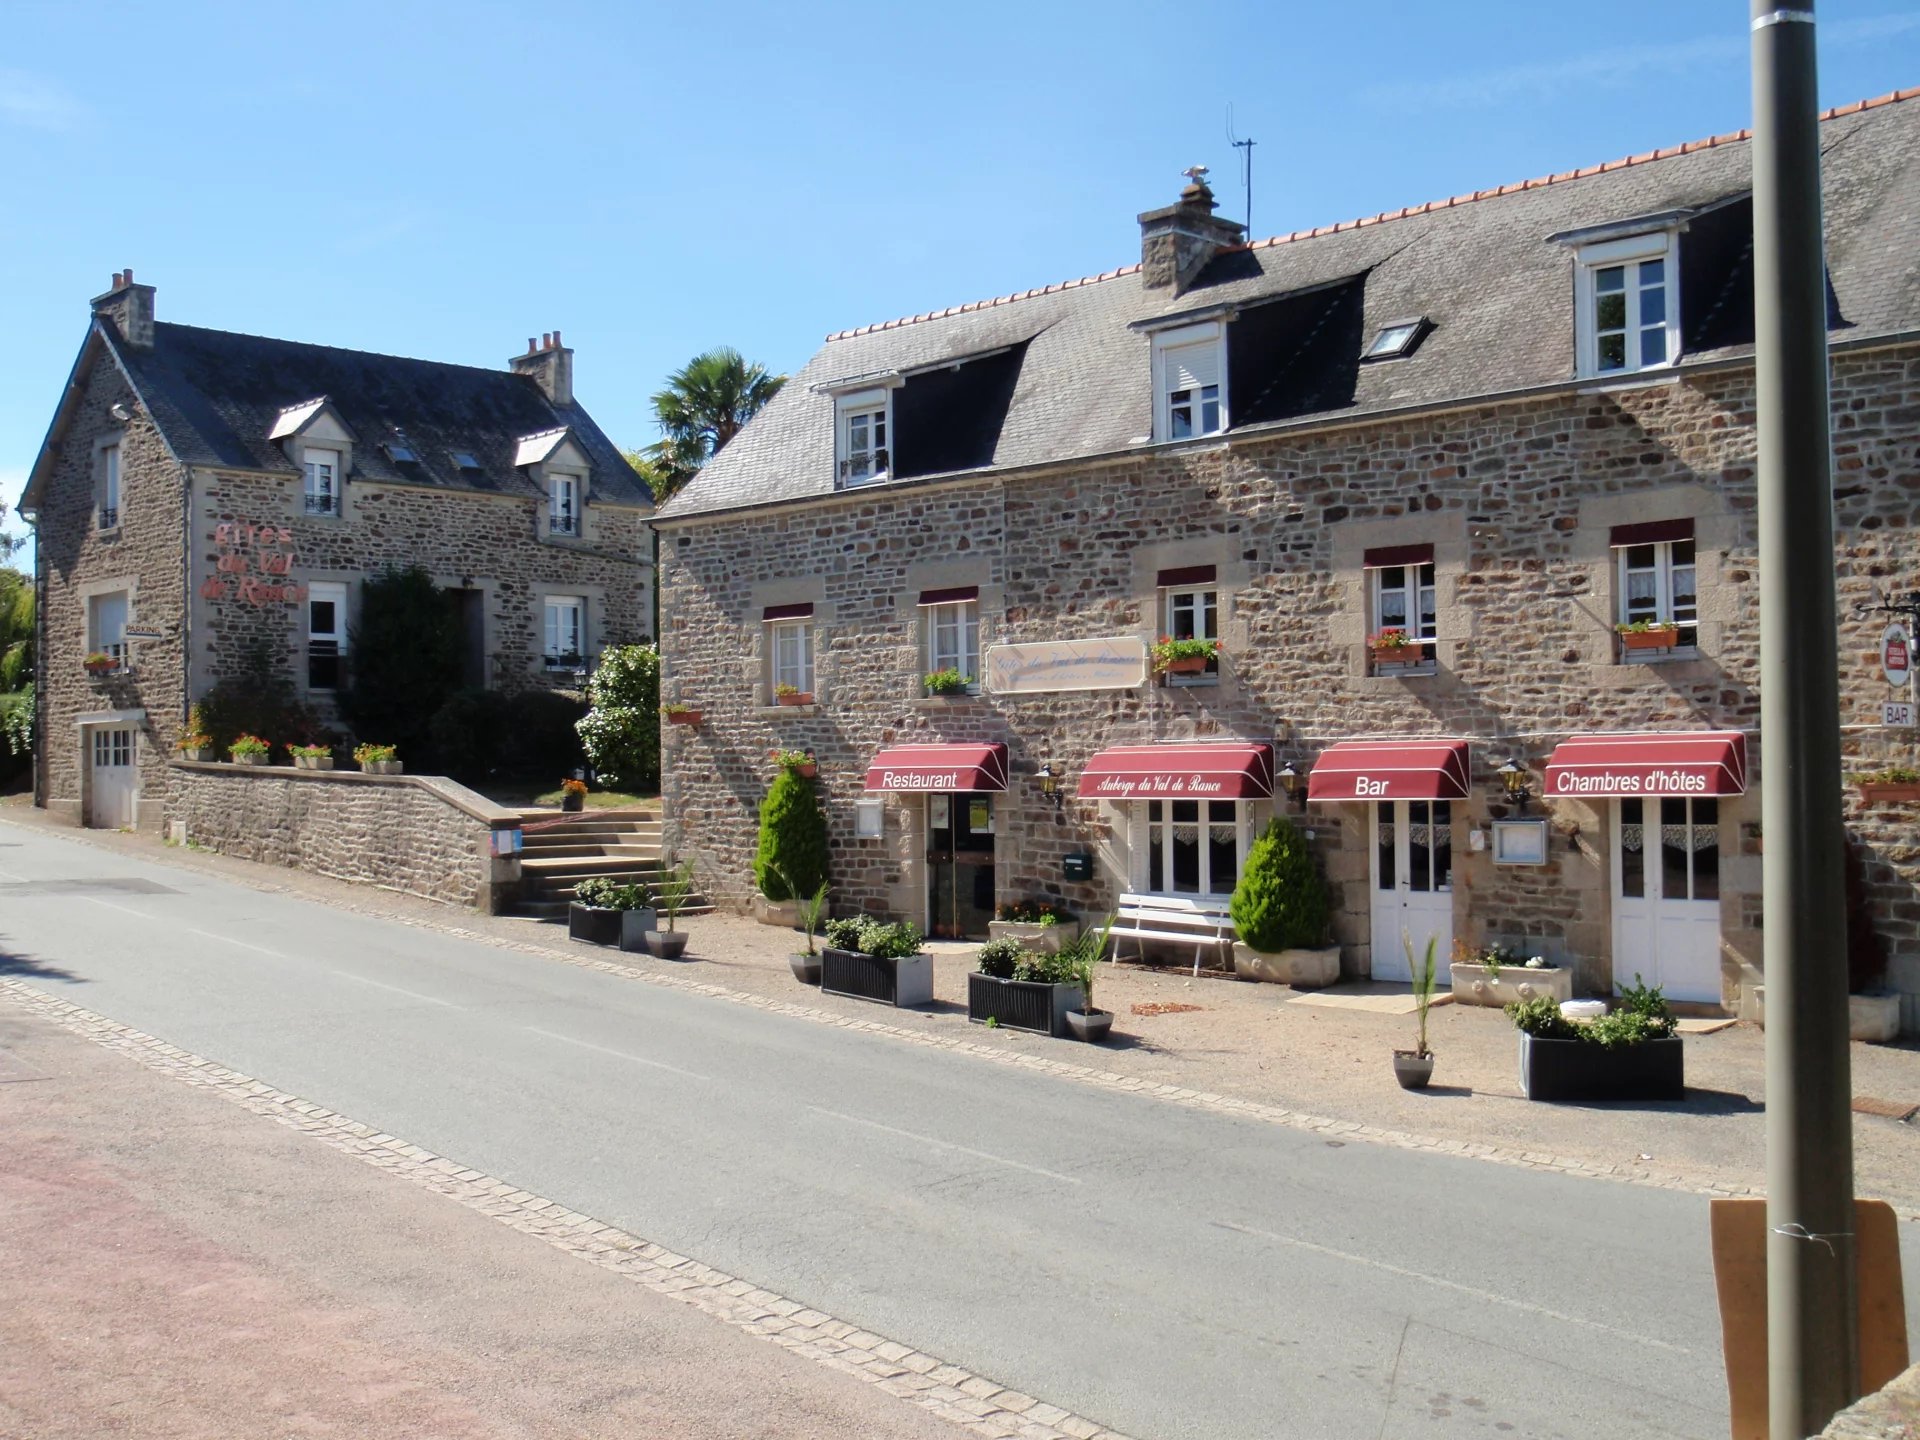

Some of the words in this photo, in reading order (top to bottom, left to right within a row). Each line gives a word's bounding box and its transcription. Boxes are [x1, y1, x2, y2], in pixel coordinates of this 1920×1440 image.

[259, 552, 294, 575] Val
[127, 624, 161, 634] PARKING
[1886, 706, 1909, 724] BAR
[882, 771, 958, 788] Restaurant
[1097, 775, 1136, 797] Auberge
[1138, 777, 1151, 791] du
[1150, 775, 1170, 791] Val
[1172, 776, 1185, 791] de
[1187, 774, 1221, 792] Rance
[1355, 776, 1390, 795] Bar
[1557, 771, 1640, 792] Chambres
[1644, 770, 1706, 791] d'hôtes
